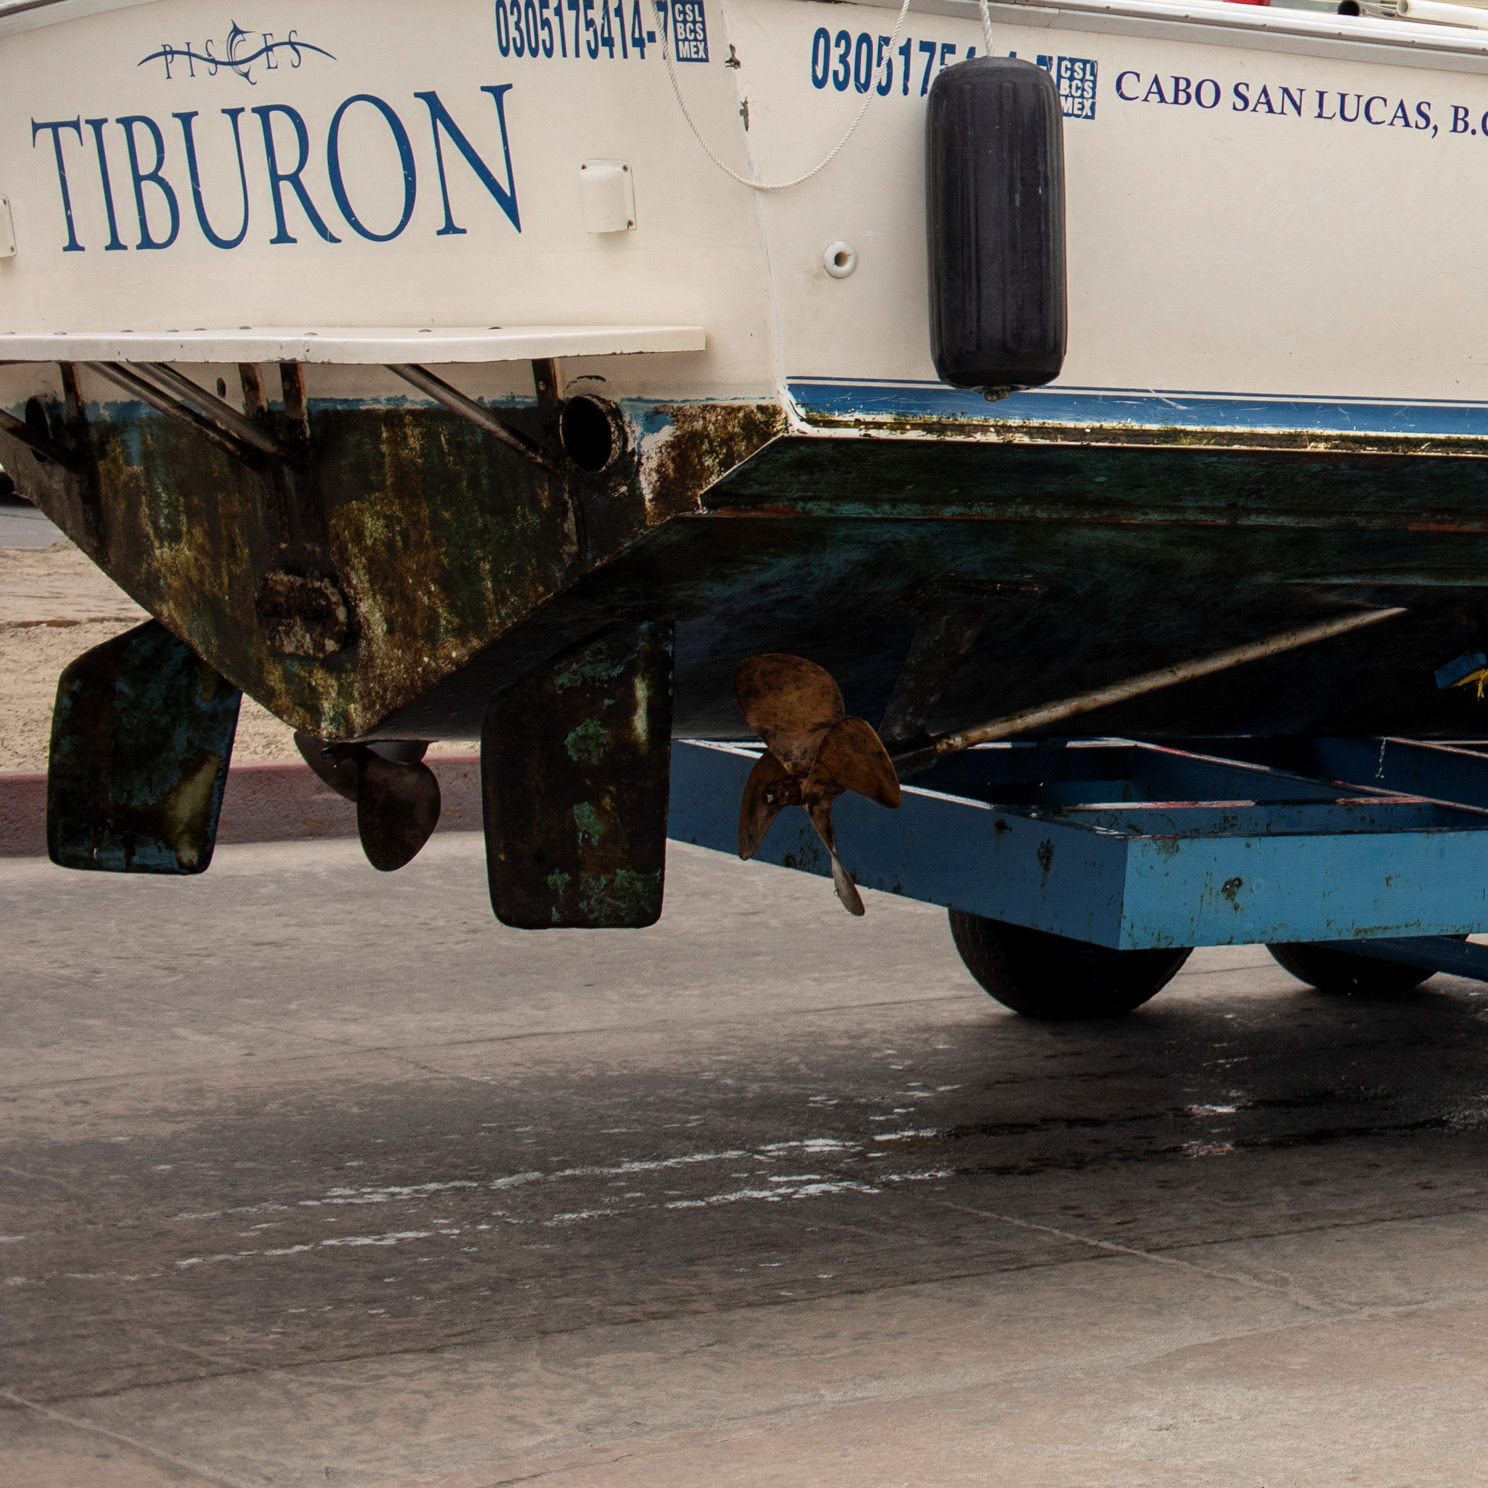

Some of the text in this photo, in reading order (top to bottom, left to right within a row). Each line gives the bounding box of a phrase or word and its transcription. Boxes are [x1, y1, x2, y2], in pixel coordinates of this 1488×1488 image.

[674, 3, 703, 23] CSL
[677, 22, 704, 41] BCS
[678, 40, 706, 59] MEX
[1061, 60, 1094, 80] CSL
[1060, 79, 1093, 99] BCS
[1060, 97, 1092, 116] MEX
[1115, 70, 1221, 109] CABO
[1232, 82, 1306, 118] SAN
[1314, 89, 1440, 139] LUCAS,
[31, 83, 521, 251] TIBURON
